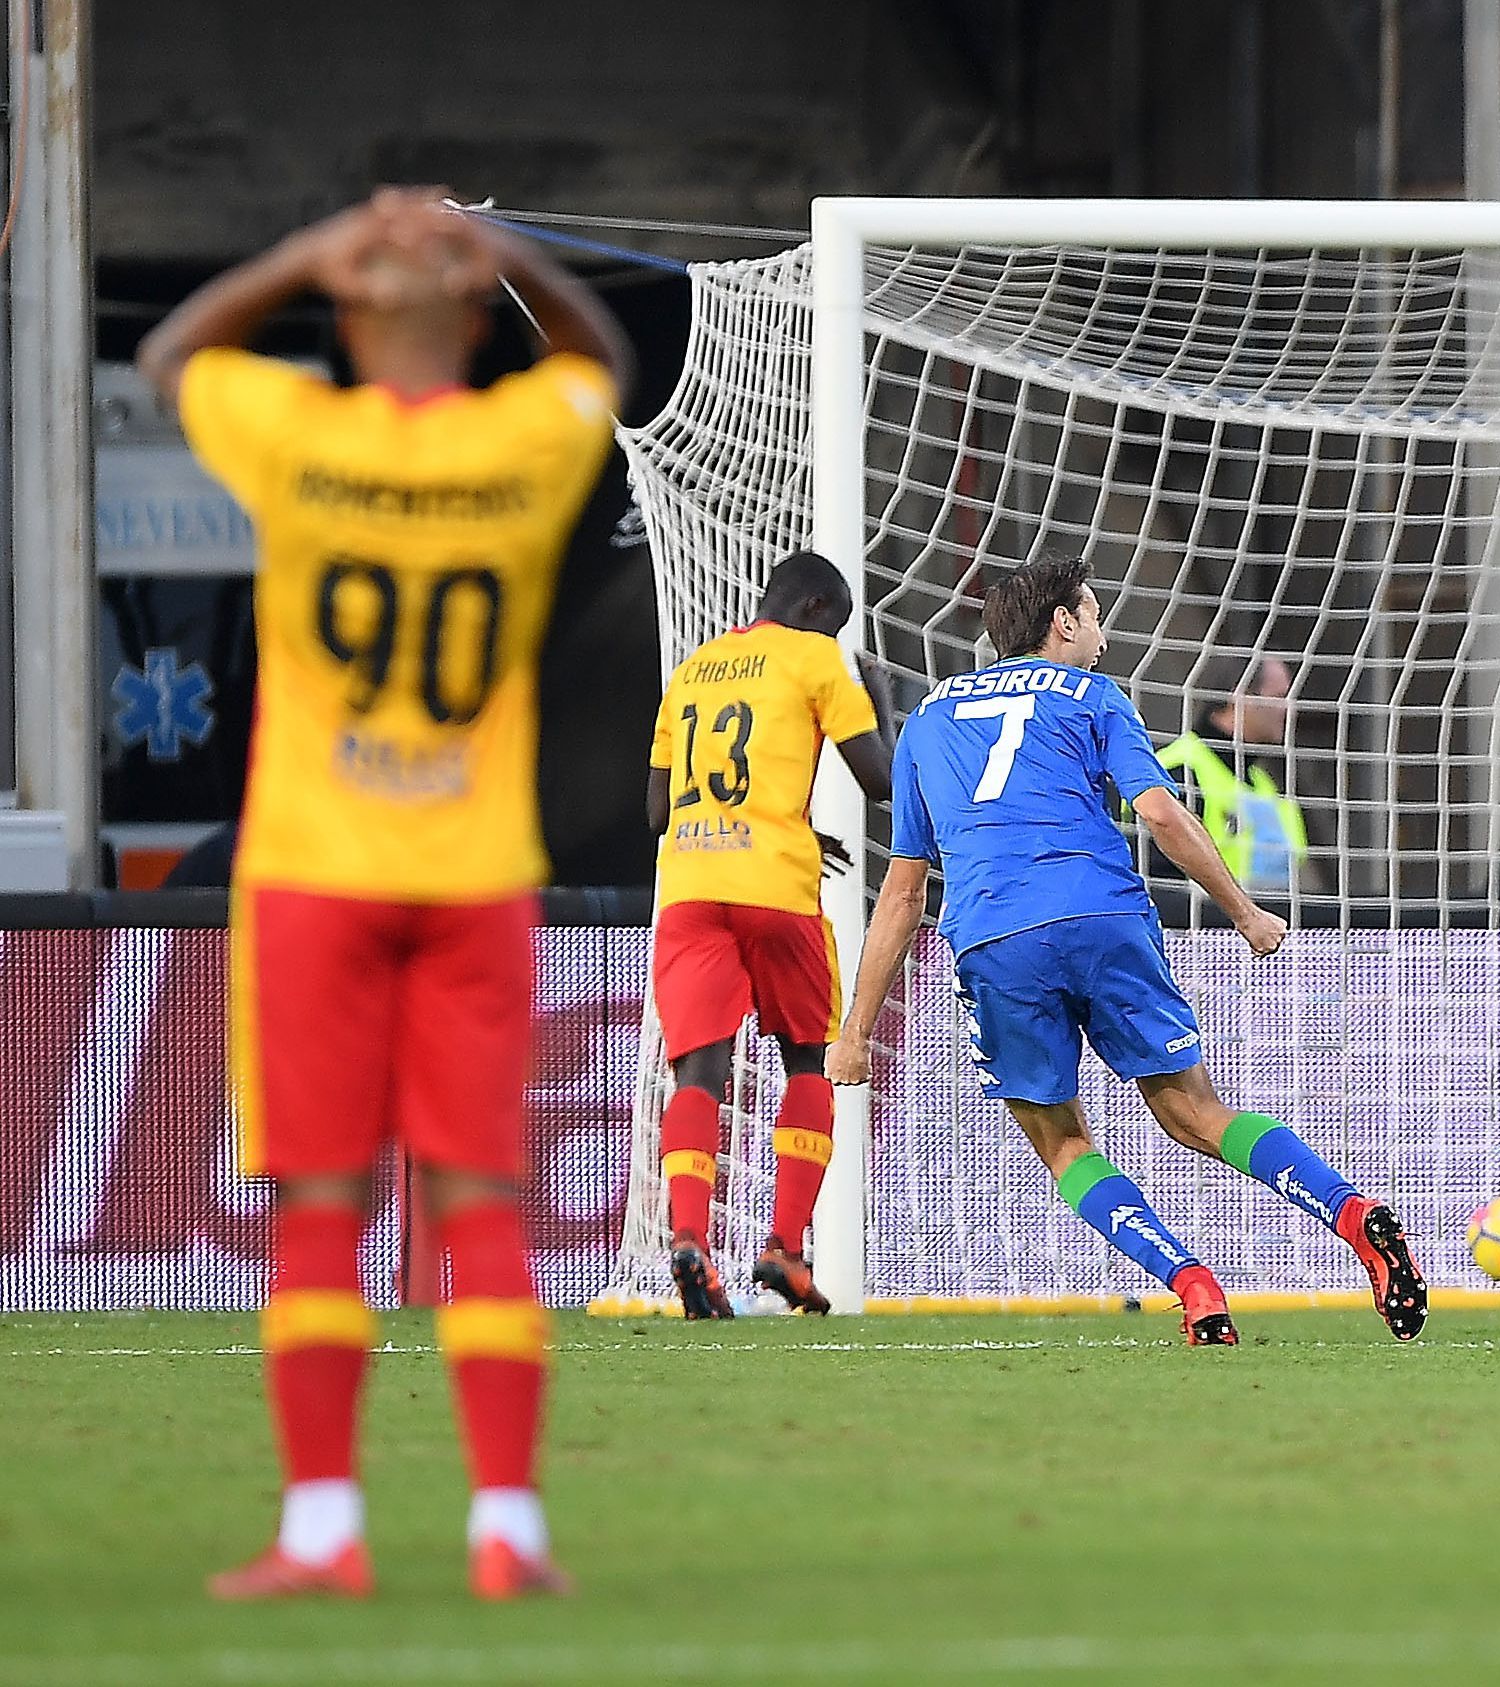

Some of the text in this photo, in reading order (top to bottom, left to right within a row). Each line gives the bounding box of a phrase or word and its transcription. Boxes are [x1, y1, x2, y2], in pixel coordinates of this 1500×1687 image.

[314, 552, 504, 726] 90
[683, 654, 767, 685] CHIBSAH
[673, 700, 754, 810] 13
[953, 693, 1036, 804] 7
